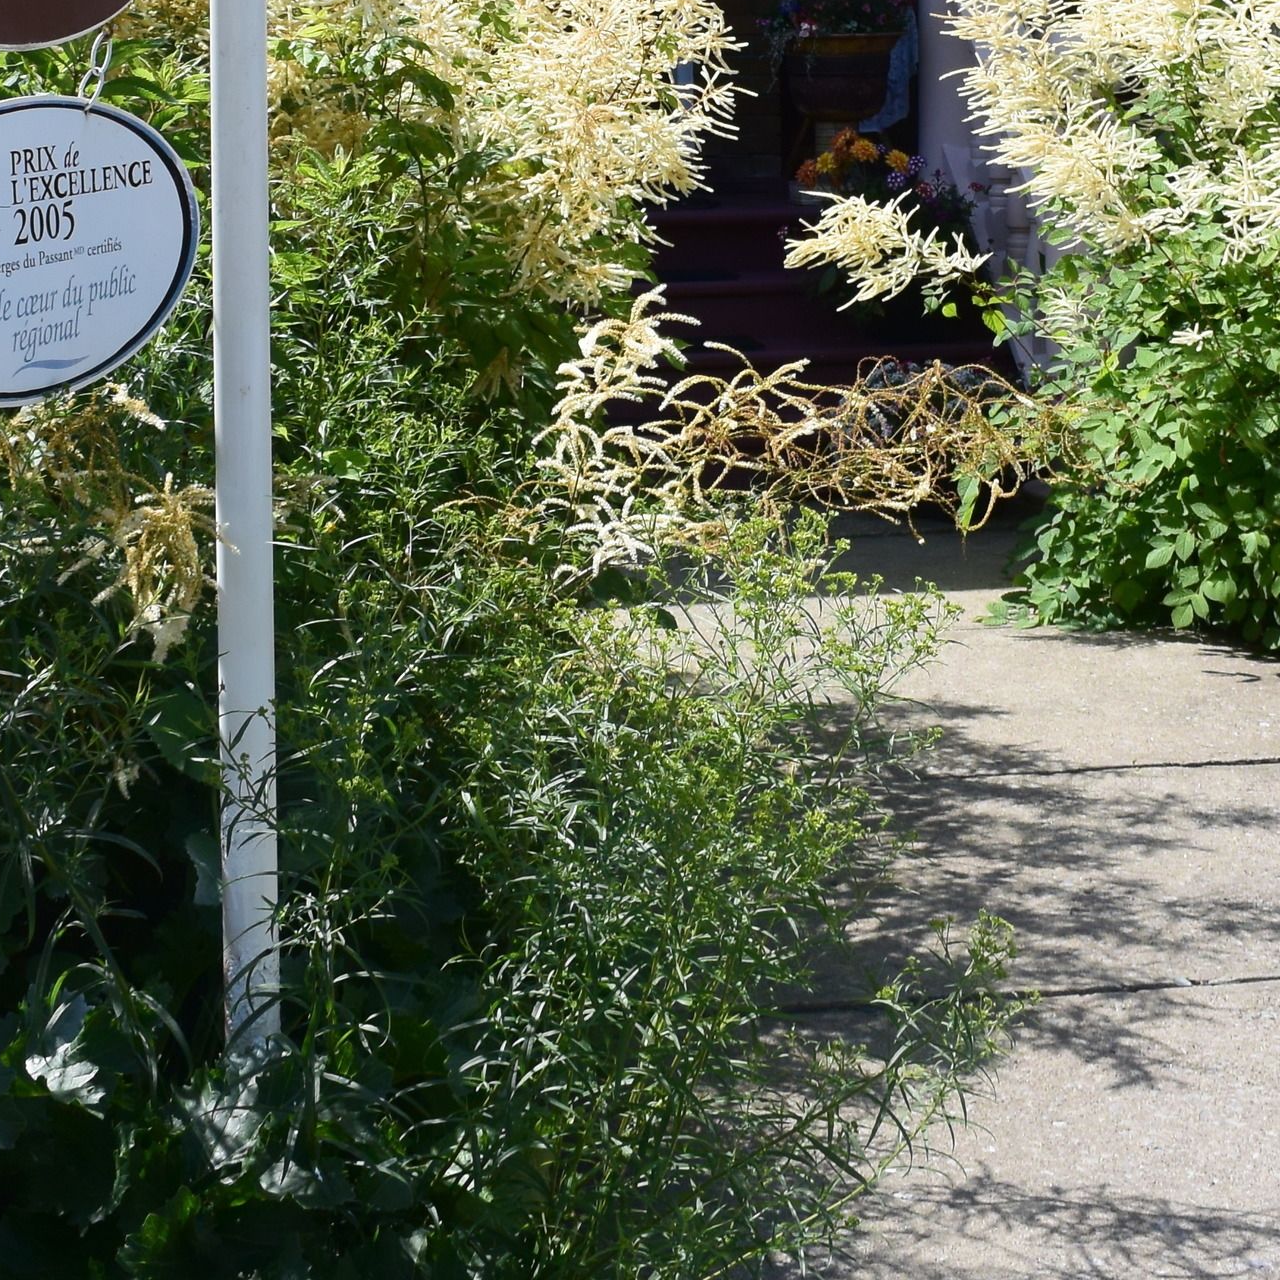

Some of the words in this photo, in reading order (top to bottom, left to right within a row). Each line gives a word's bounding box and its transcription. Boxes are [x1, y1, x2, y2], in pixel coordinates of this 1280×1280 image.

[10, 145, 57, 176] PRIX
[64, 141, 80, 168] de
[11, 160, 153, 205] L'EXCELLENCE
[13, 200, 75, 245] 2005
[23, 254, 36, 269] du
[87, 237, 122, 256] certifiés
[16, 290, 58, 317] cœur
[62, 274, 84, 307] du
[87, 264, 137, 316] public
[12, 305, 82, 362] régional
